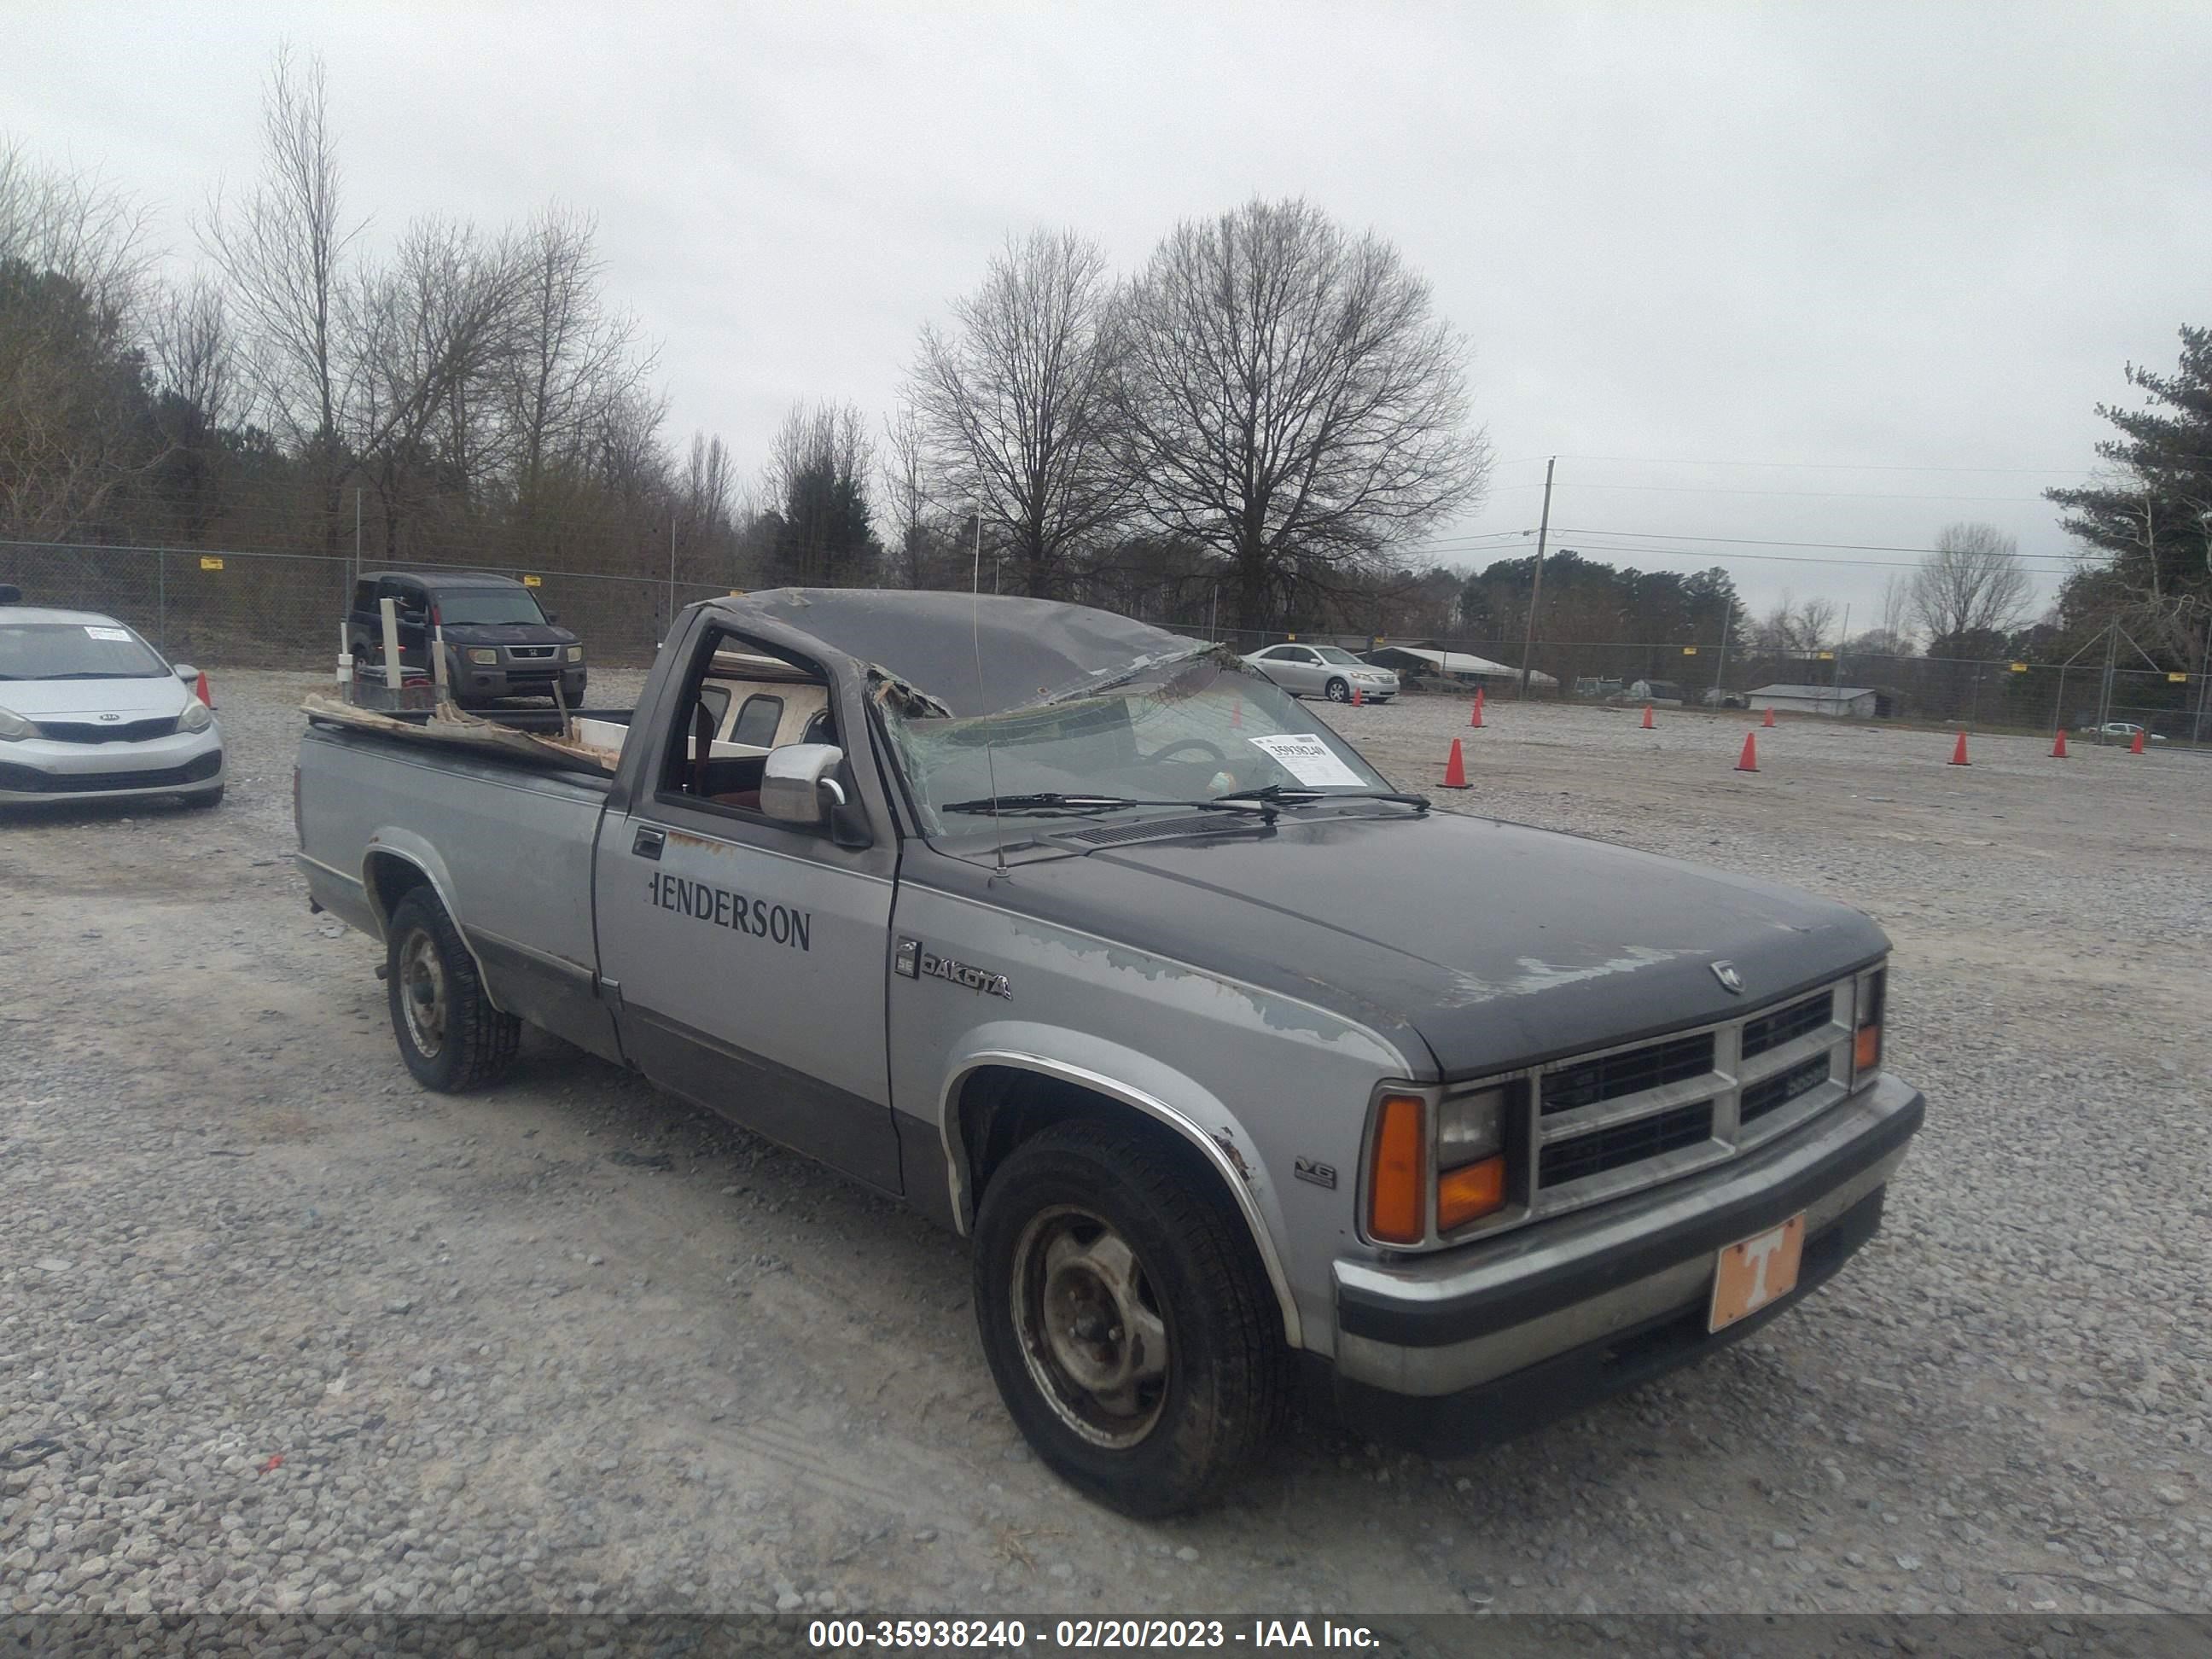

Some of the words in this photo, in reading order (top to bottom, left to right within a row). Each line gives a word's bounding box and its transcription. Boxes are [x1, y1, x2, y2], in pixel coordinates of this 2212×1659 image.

[922, 953, 1012, 1001] DAKOTA
[1296, 1156, 1334, 1179] V6
[1743, 1227, 1785, 1310] T
